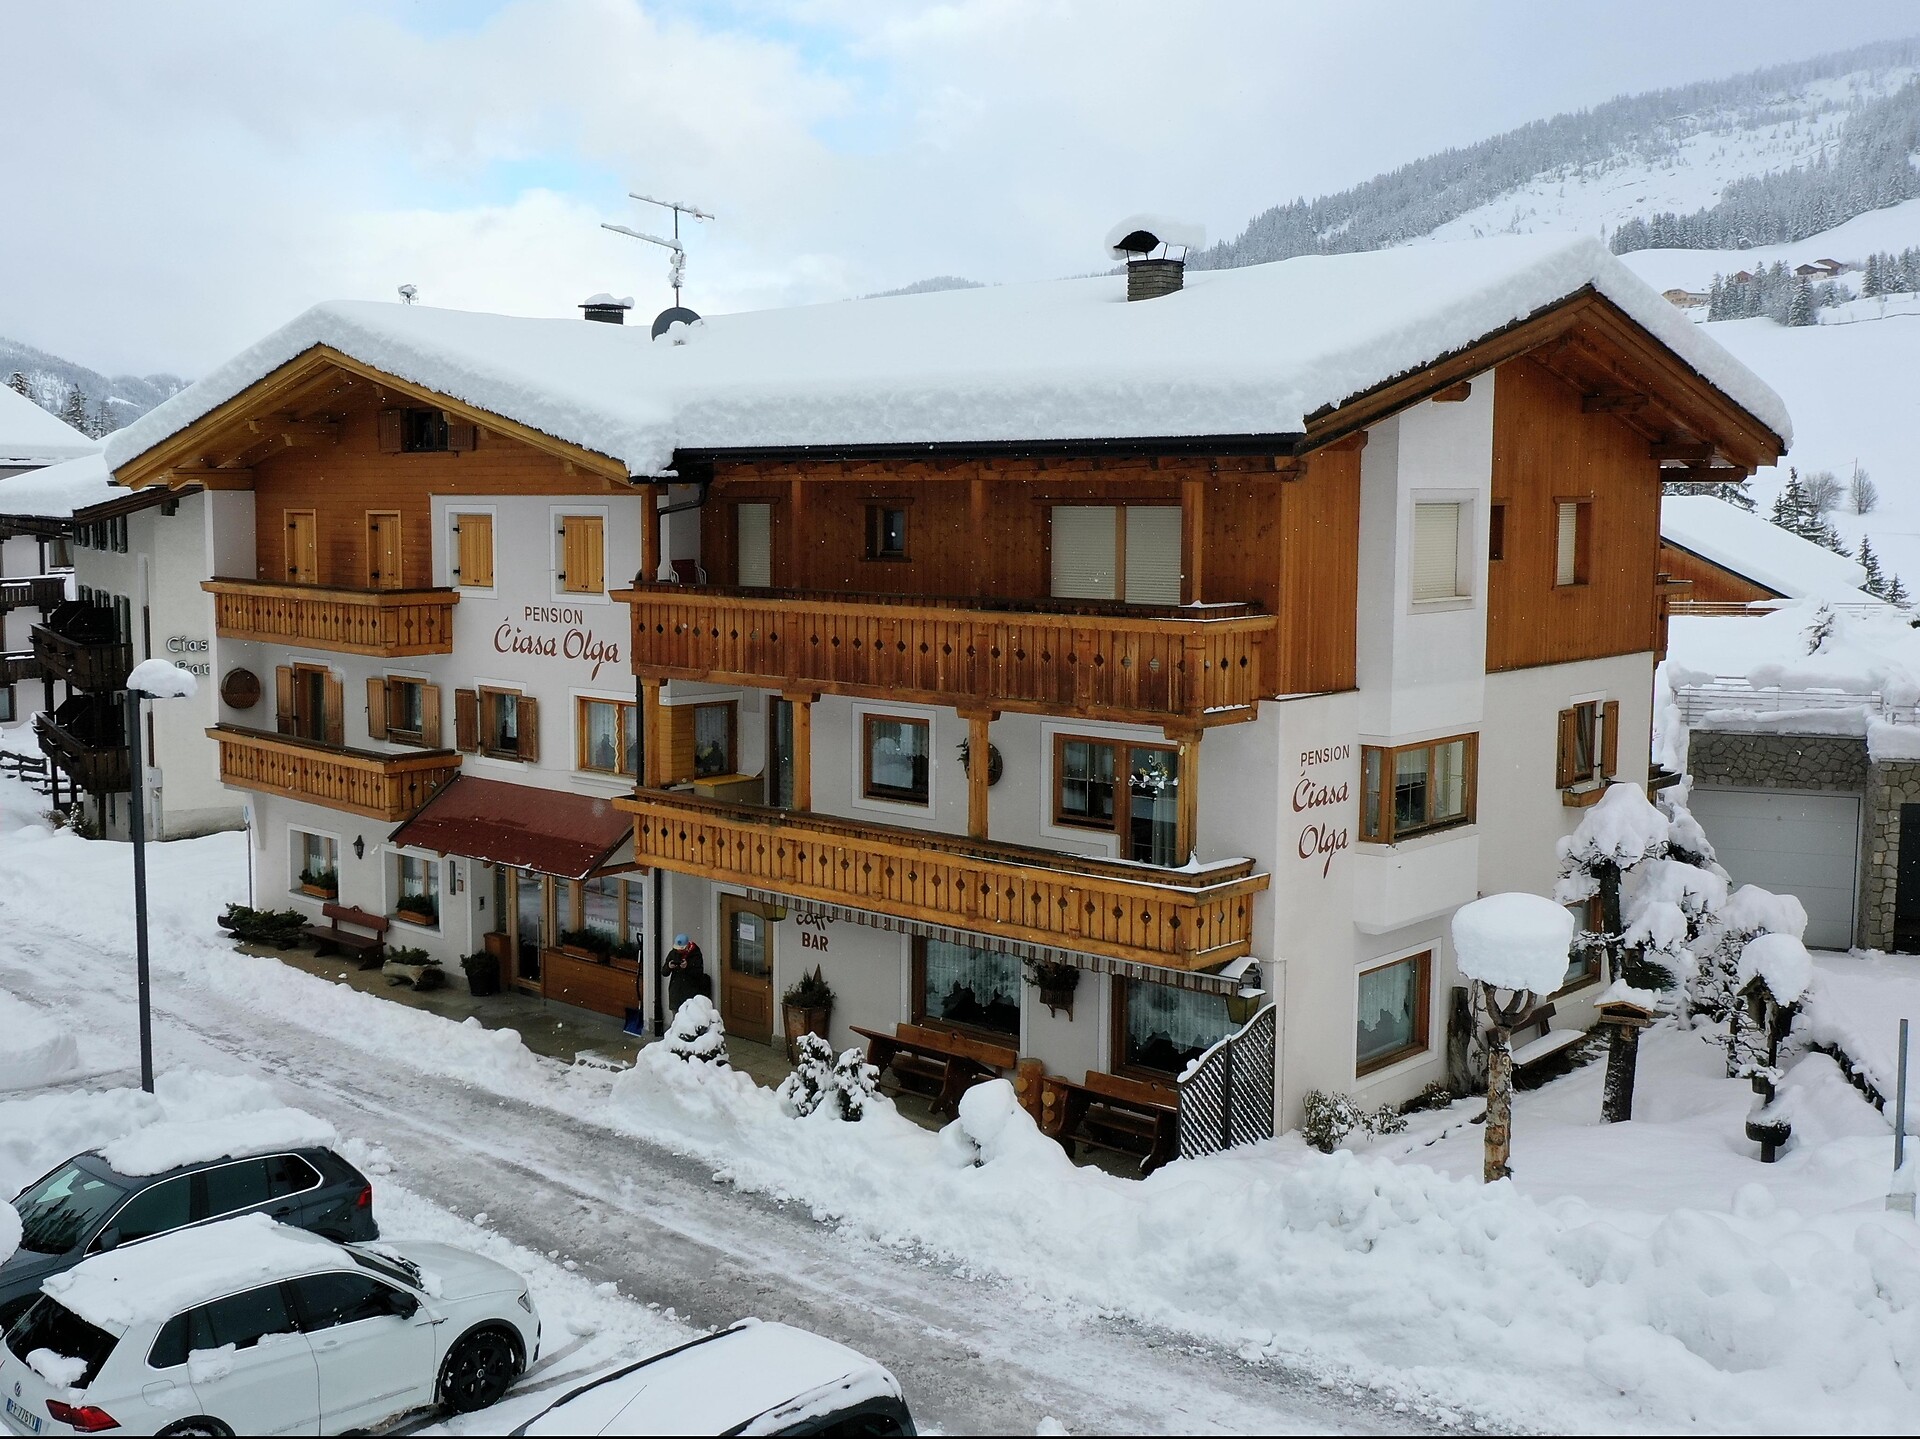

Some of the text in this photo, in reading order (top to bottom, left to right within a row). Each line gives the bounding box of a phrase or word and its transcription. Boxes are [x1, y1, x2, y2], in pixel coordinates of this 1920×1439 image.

[524, 606, 583, 624] PENSION
[563, 628, 621, 681] Olga
[1300, 744, 1350, 767] PENSION
[1298, 822, 1349, 879] Olga
[802, 931, 829, 952] BAR
